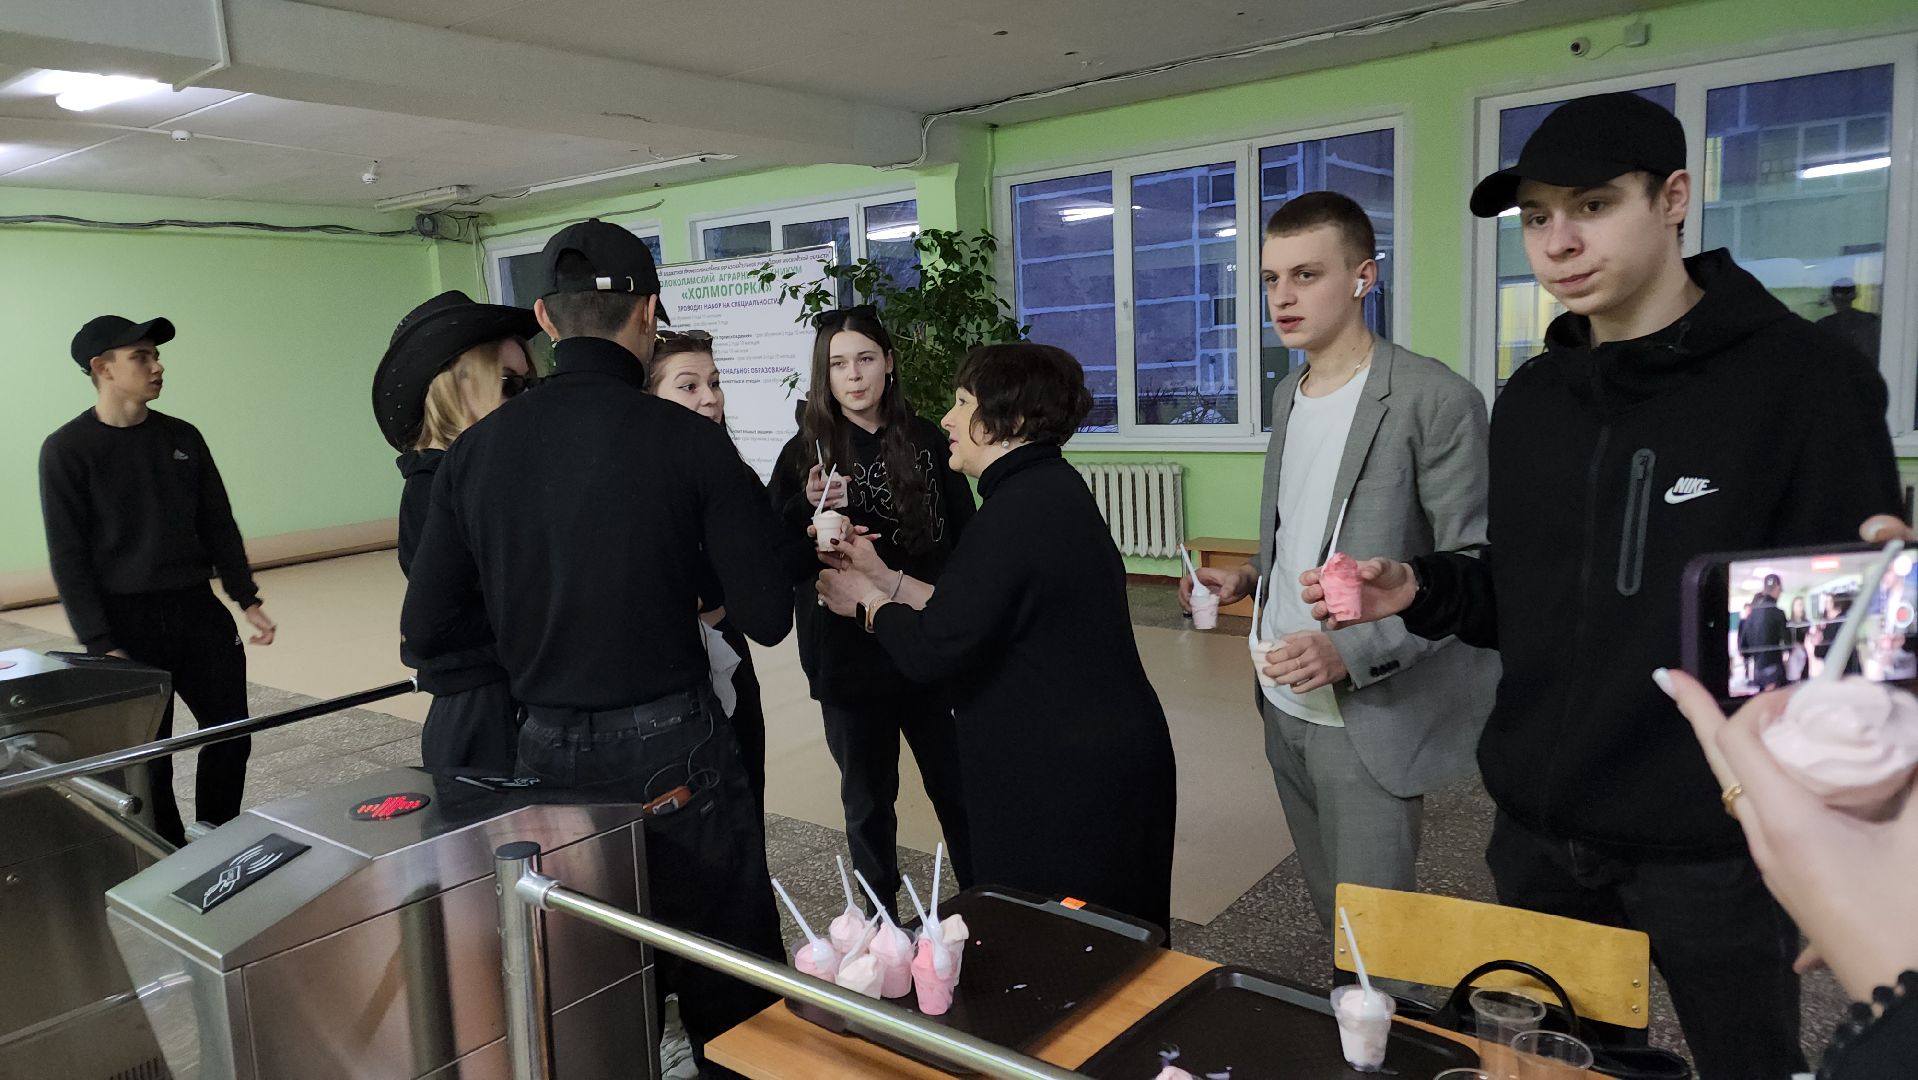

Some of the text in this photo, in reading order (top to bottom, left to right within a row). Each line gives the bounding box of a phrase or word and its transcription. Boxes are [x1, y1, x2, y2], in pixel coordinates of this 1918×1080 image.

[660, 273, 715, 288] ОЛОКОЛАМСКИЙ
[718, 267, 759, 282] АГРАРНЫ
[1672, 476, 1711, 494] NIKE
